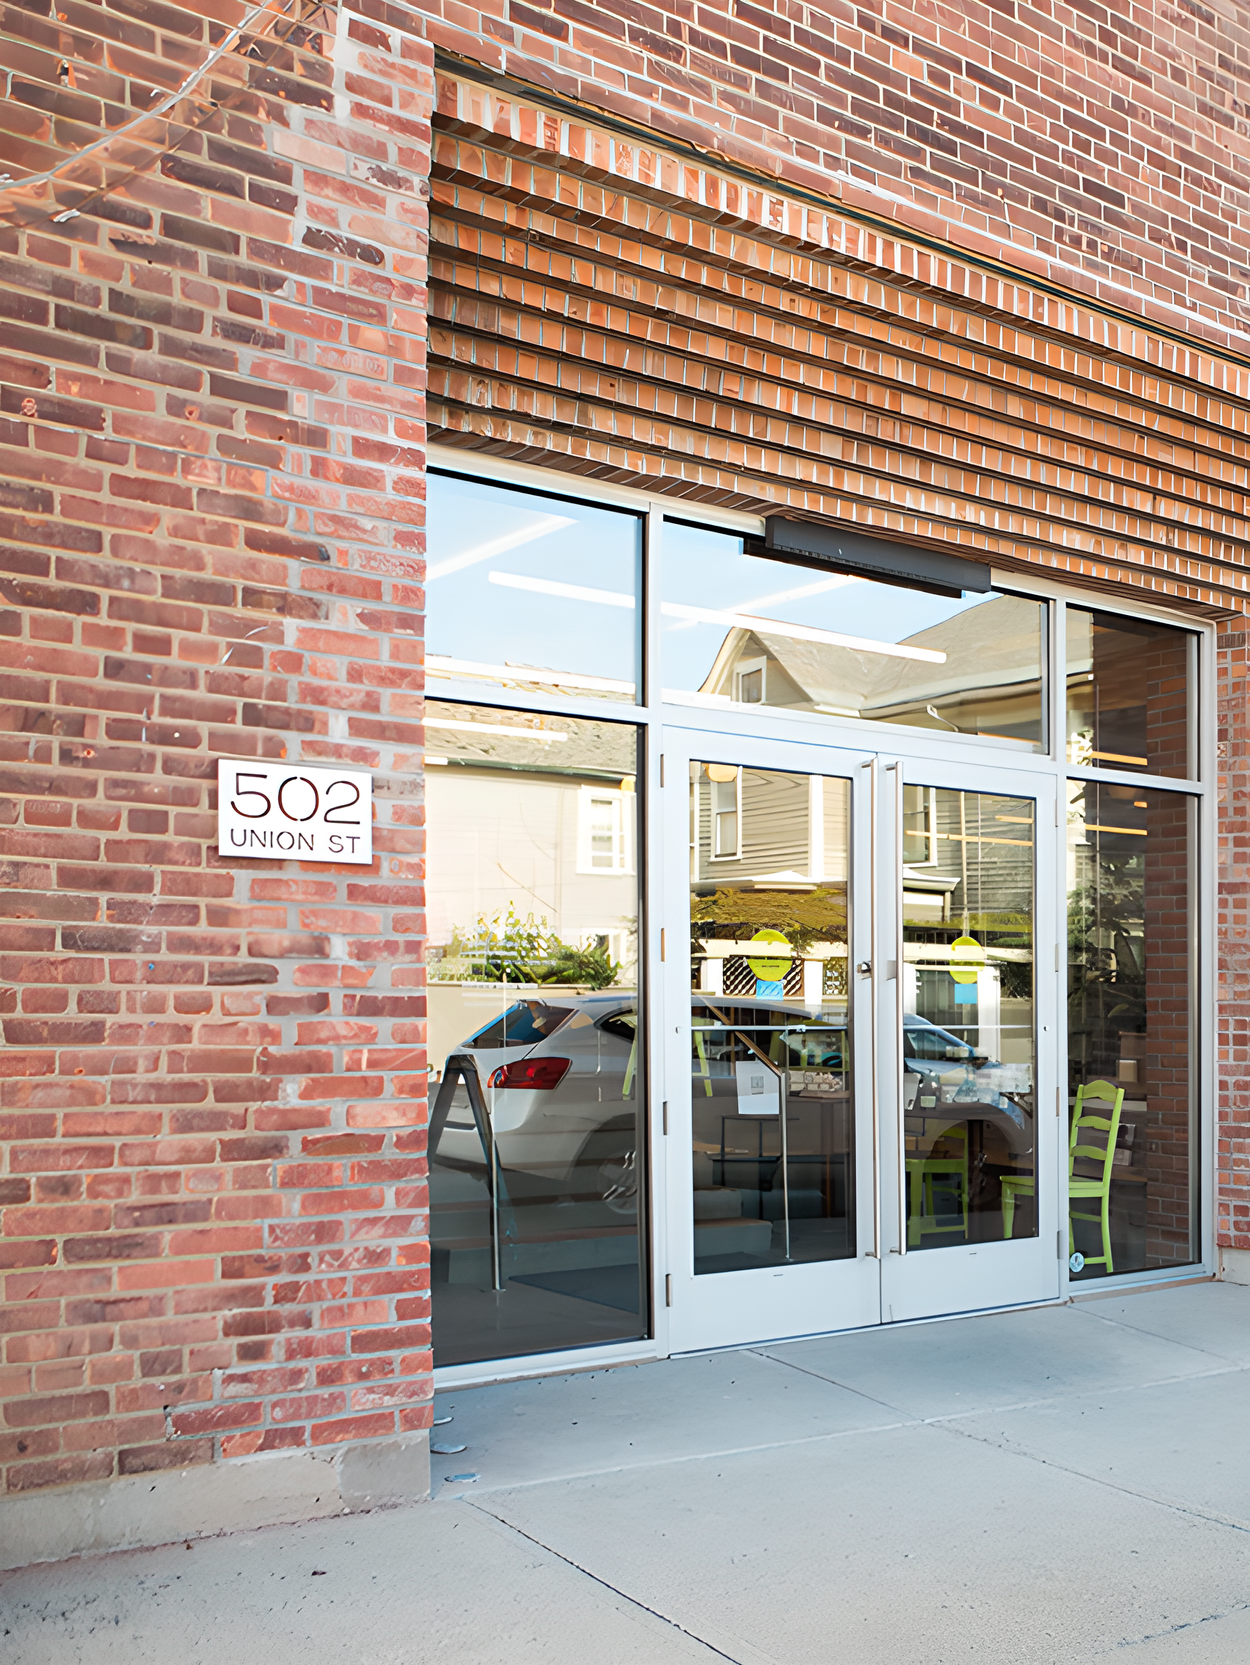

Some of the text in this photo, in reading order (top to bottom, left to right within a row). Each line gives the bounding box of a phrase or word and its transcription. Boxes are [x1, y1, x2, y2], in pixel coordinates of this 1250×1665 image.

[230, 772, 361, 825] 502
[230, 828, 361, 853] UNION ST
